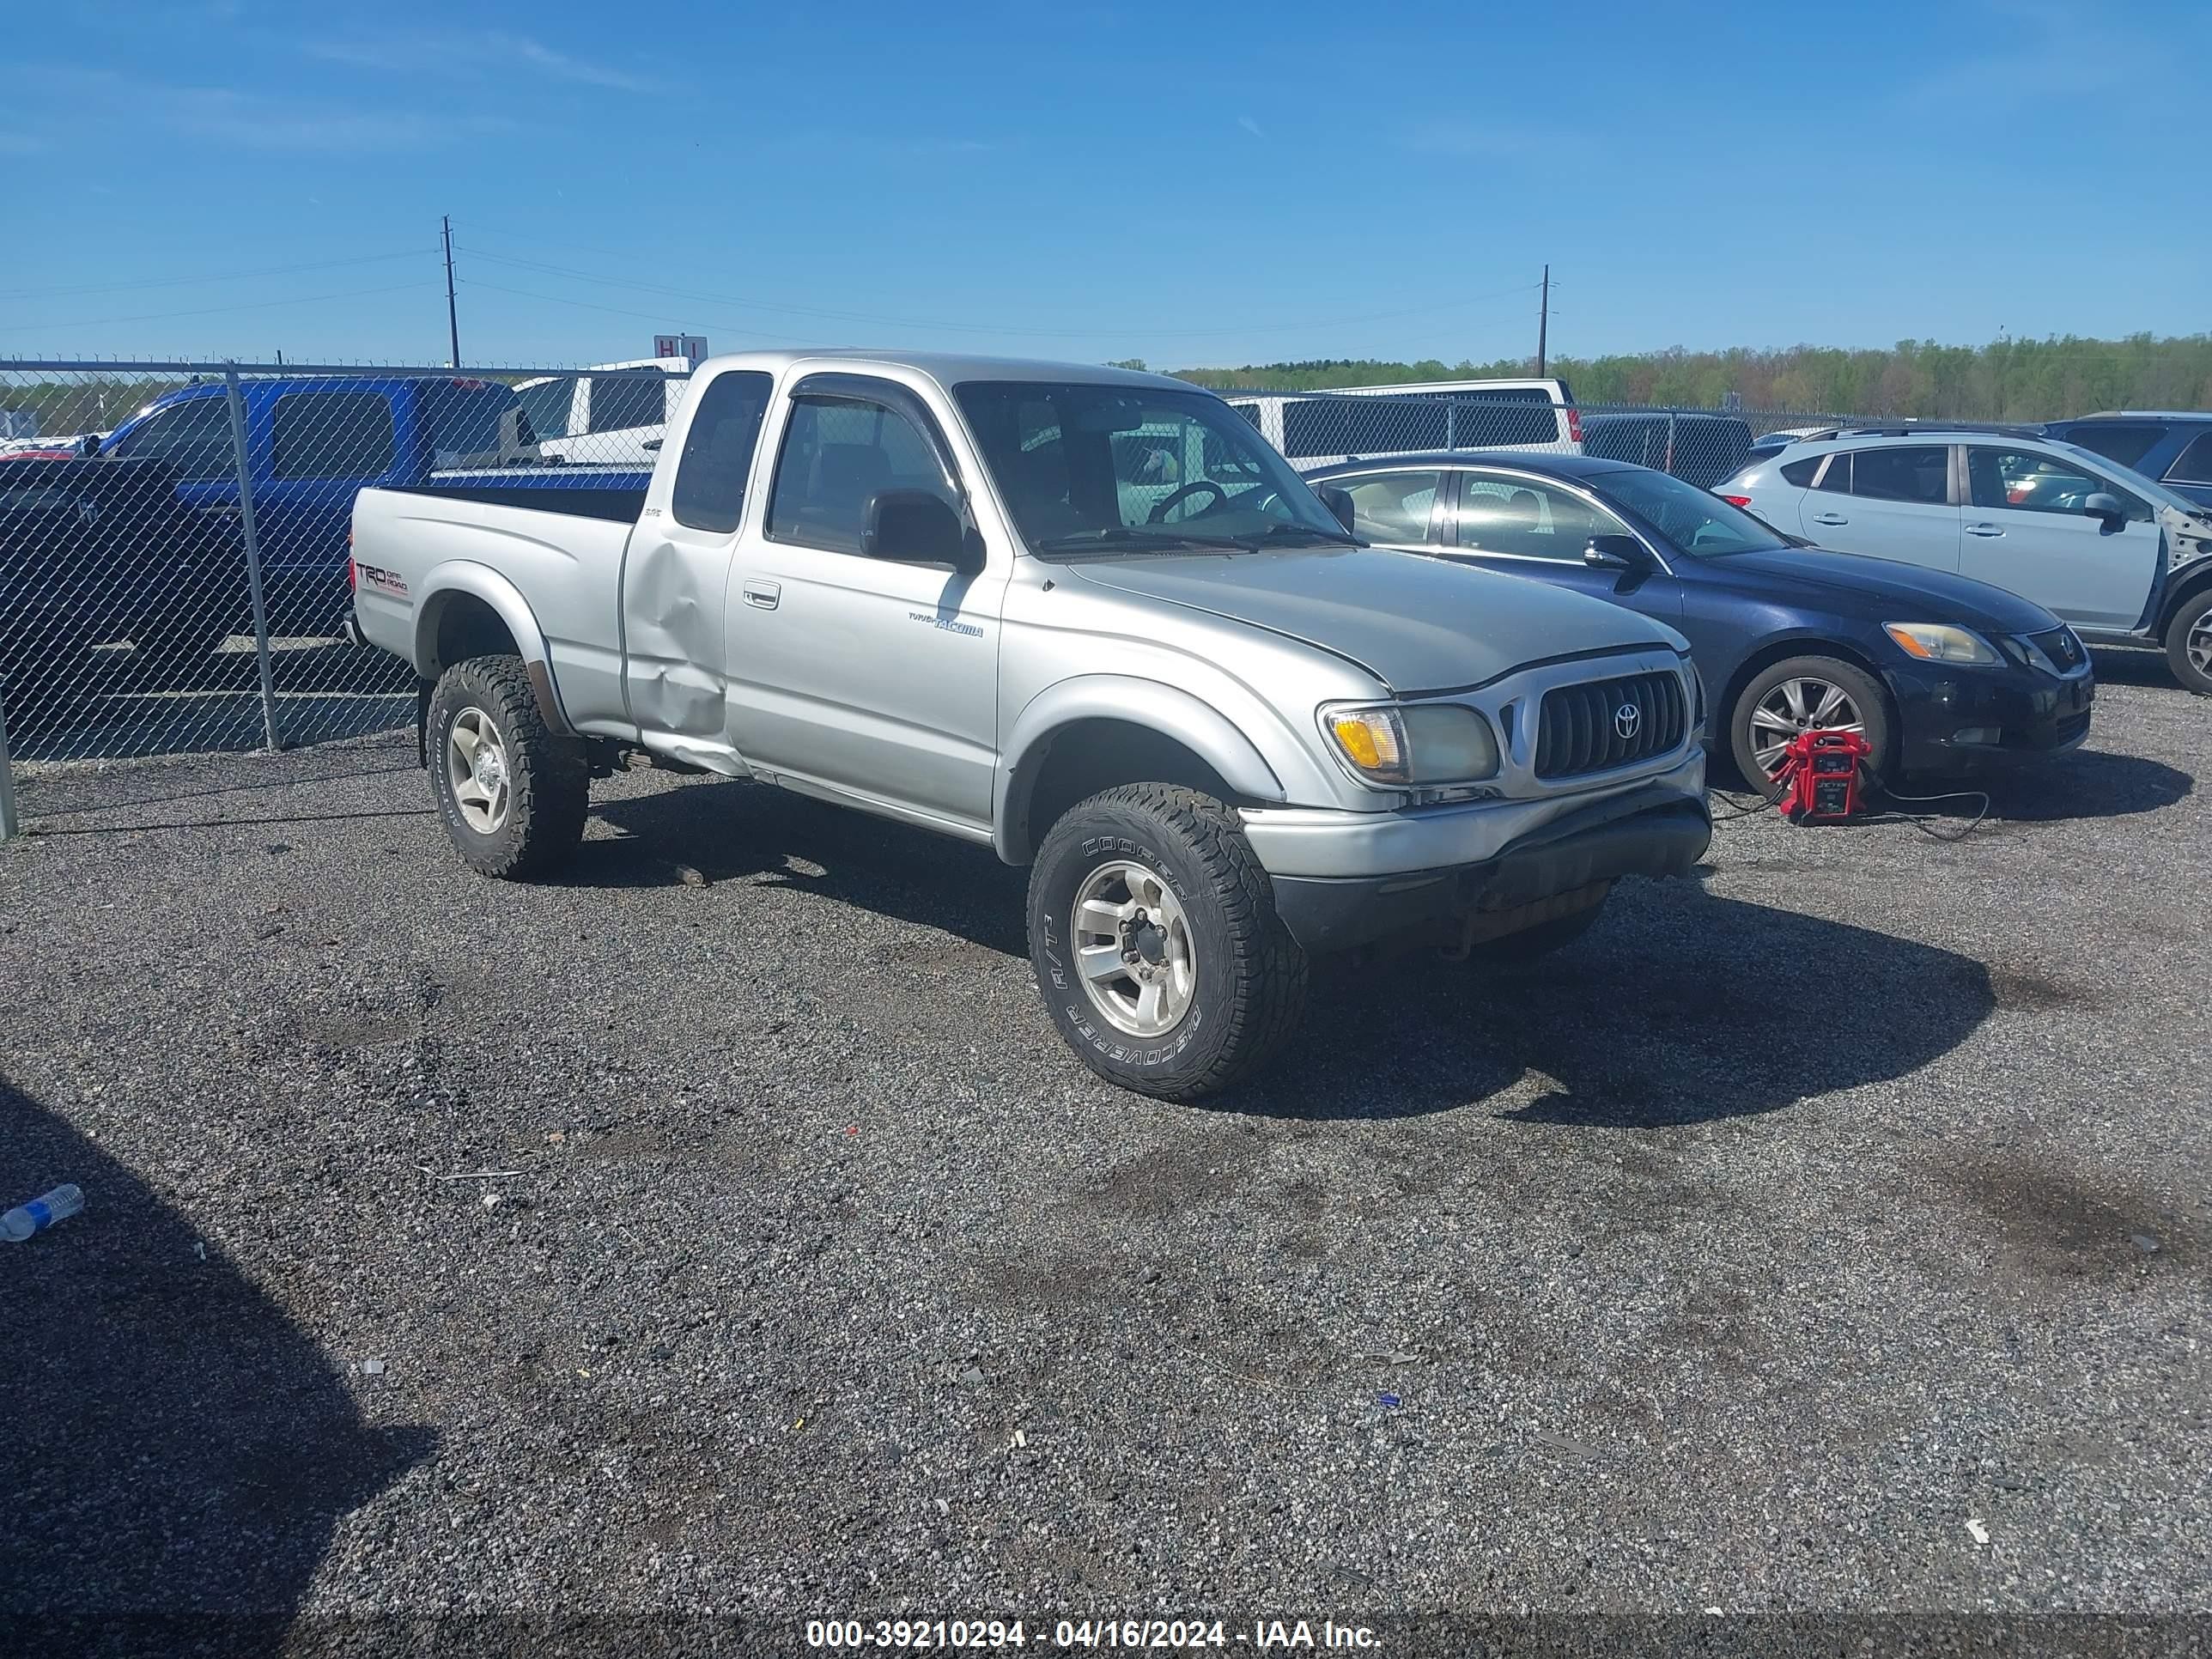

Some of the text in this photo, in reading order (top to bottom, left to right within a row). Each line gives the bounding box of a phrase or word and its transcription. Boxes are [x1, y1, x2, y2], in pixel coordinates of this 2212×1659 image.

[659, 340, 674, 358] H
[356, 562, 386, 586] TRD
[386, 570, 402, 580] OFF
[386, 579, 408, 590] ROAD
[933, 618, 984, 638] TACOMA
[1082, 836, 1188, 902] COOPER
[1066, 1003, 1202, 1066] DISCOVERER
